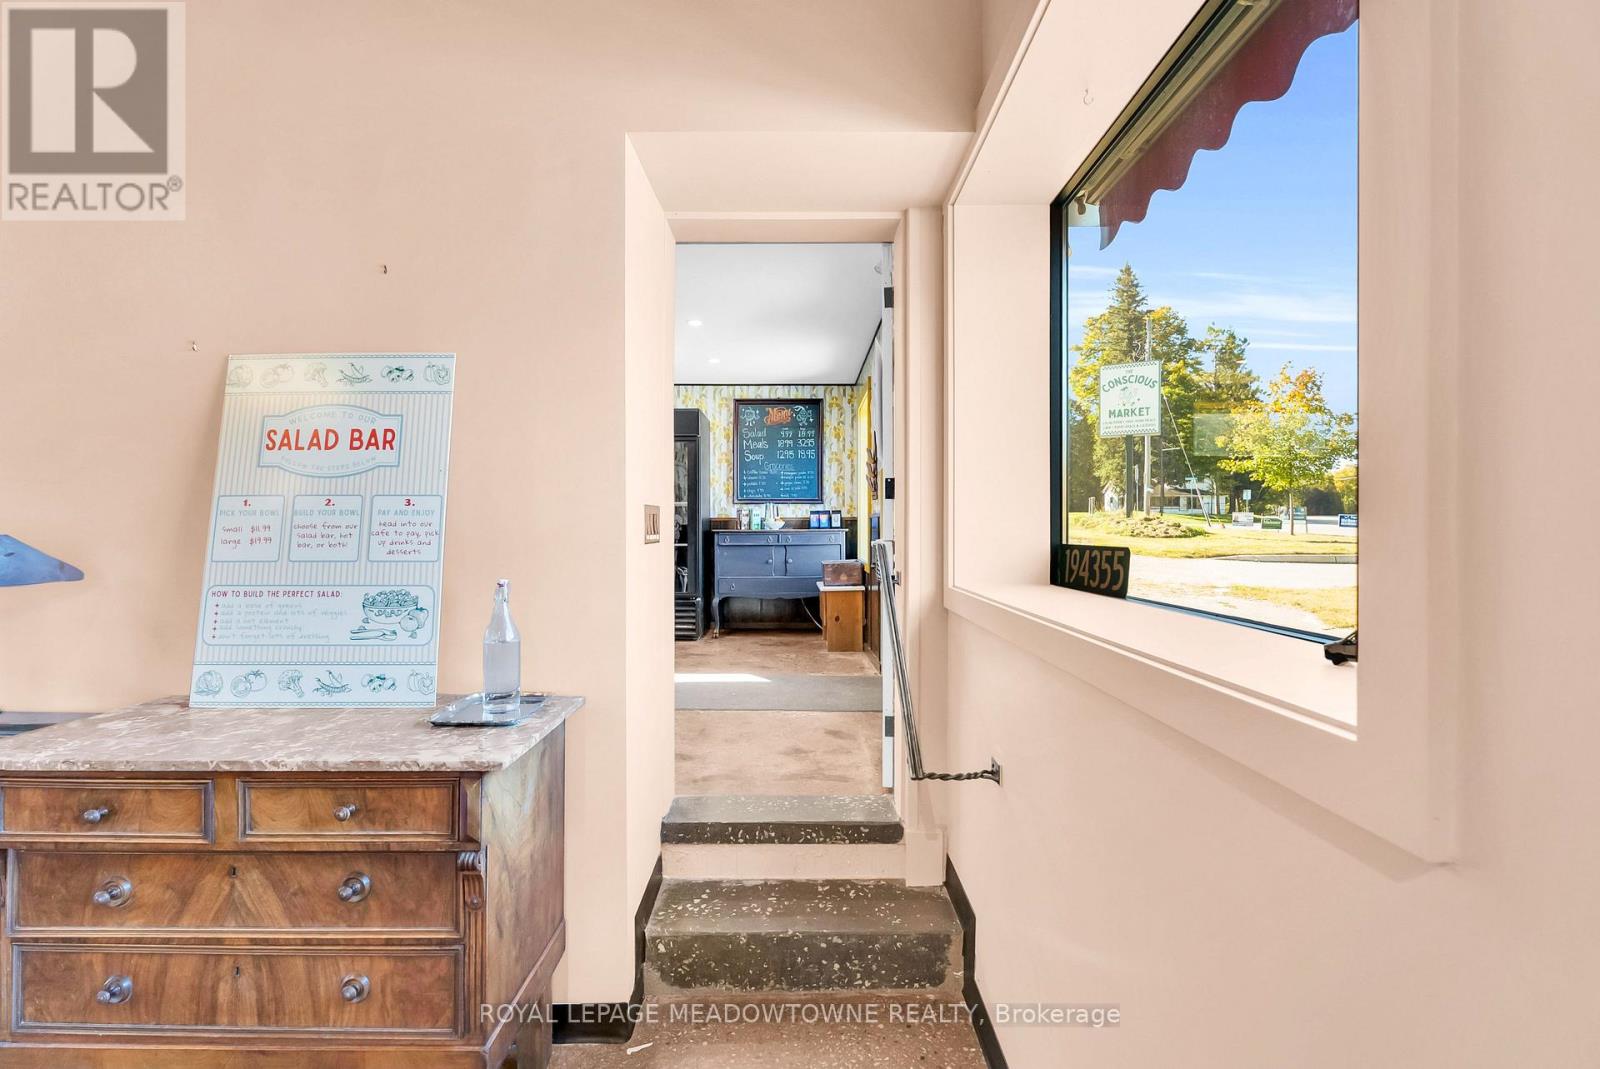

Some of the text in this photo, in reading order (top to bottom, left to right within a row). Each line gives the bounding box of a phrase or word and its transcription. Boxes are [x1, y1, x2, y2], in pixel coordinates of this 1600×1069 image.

[1102, 375, 1158, 392] CONSCIOUS
[289, 411, 377, 425] WELCOME TO OUR
[1108, 407, 1151, 419] MARKET
[743, 427, 767, 439] Salad
[265, 428, 397, 451] SALAD BAR
[743, 438, 769, 450] Meals
[744, 450, 765, 465] Soup
[243, 499, 251, 507] 1.
[324, 498, 335, 506] 2.
[404, 498, 415, 506] 3.
[322, 522, 342, 530] from
[424, 529, 440, 538] pick
[220, 538, 241, 550] large
[1065, 549, 1125, 591] 194355
[211, 590, 228, 598] HOW
[231, 590, 241, 598] TO
[243, 590, 264, 598] BUILD
[267, 590, 281, 598] THE
[282, 590, 314, 598] PERFECT
